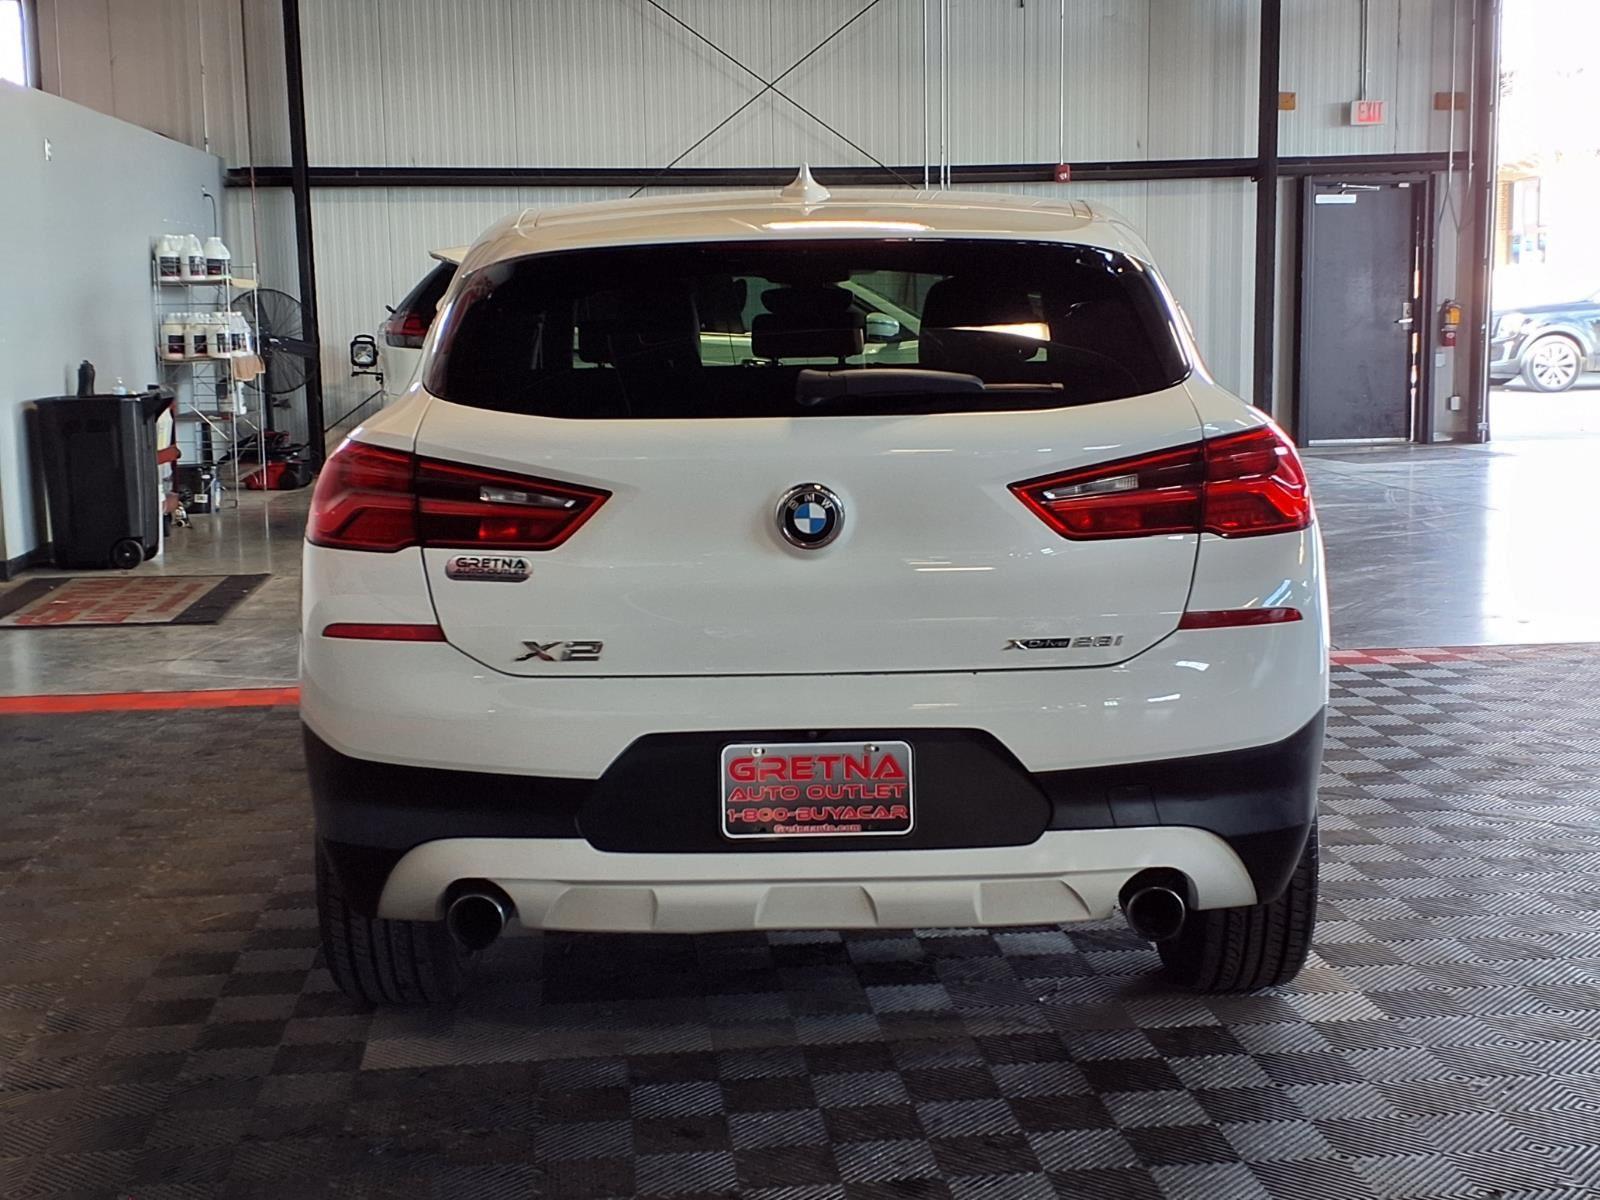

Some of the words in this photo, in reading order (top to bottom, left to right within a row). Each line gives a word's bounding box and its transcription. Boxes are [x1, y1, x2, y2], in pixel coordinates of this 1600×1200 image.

[1358, 101, 1384, 122] EXIT
[788, 493, 833, 510] BMW
[455, 557, 526, 569] GRETNA
[513, 641, 603, 661] X2
[728, 753, 905, 782] GRETNA
[727, 785, 799, 802] AUTO
[806, 783, 907, 799] OUTLET
[726, 805, 908, 823] 1-800-BUYACAR
